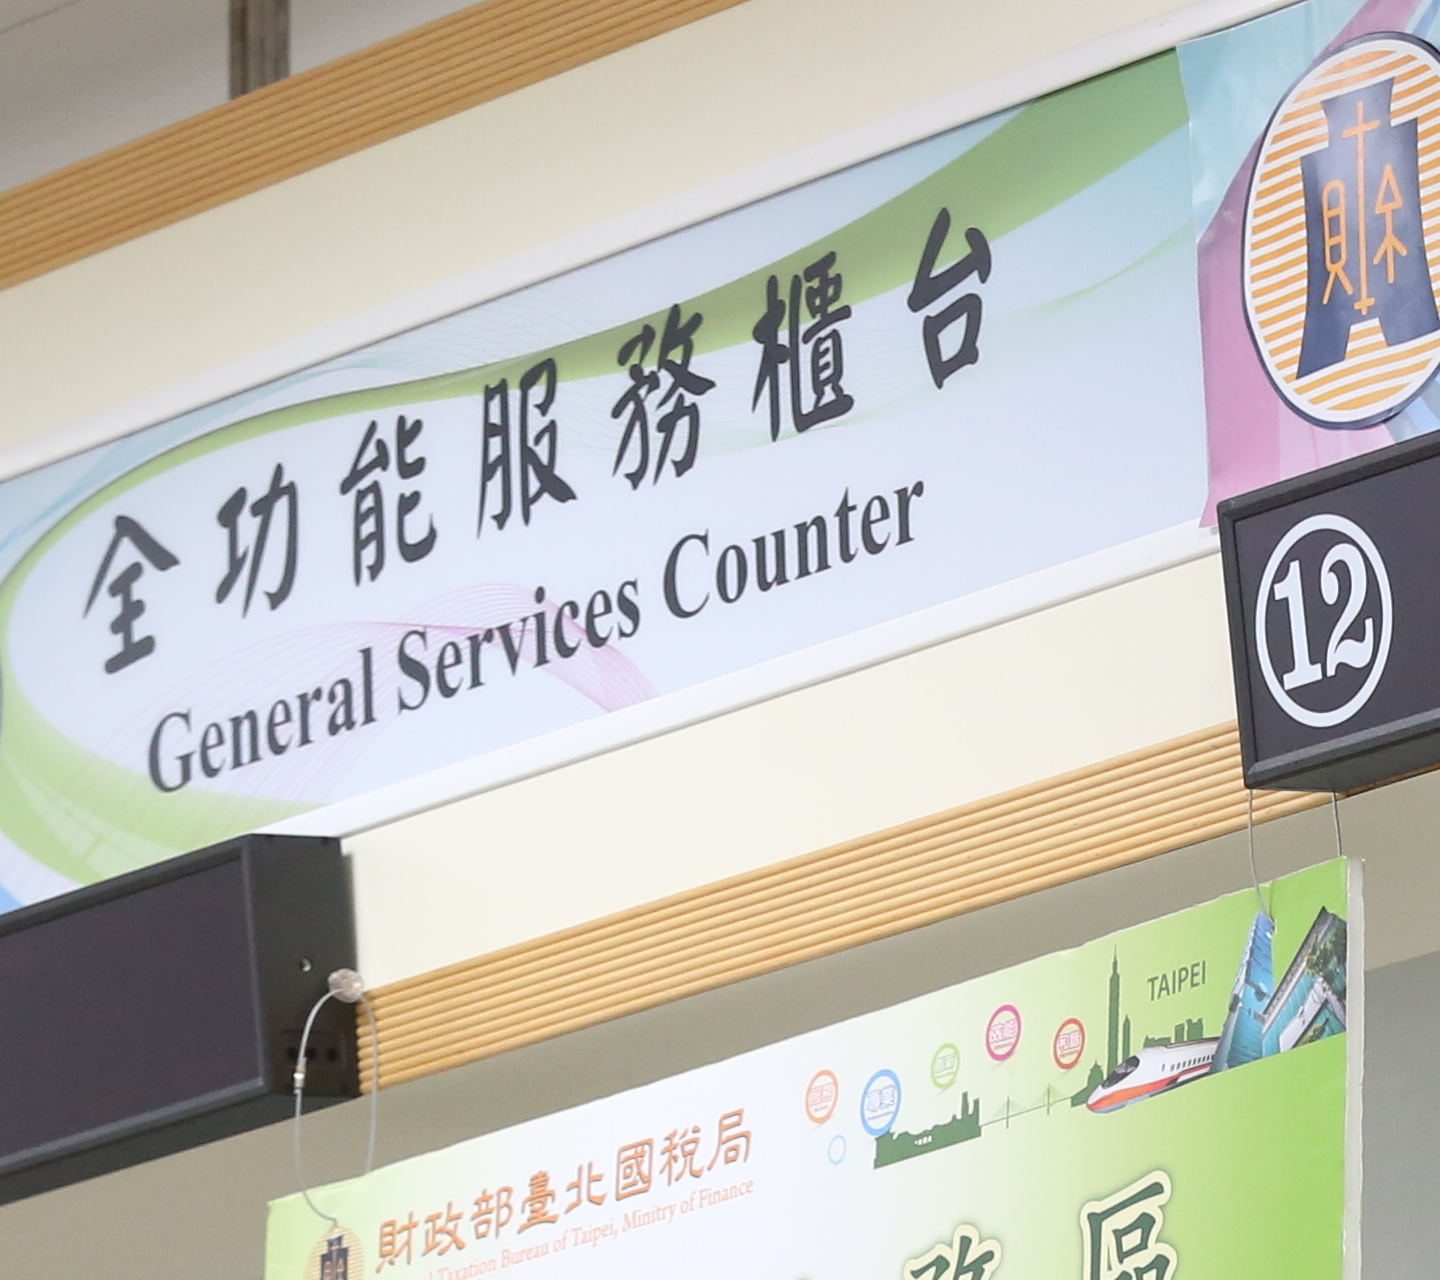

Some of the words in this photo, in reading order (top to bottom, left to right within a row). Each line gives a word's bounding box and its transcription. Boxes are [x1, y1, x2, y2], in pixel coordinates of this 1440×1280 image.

[82, 206, 992, 676] 全功能服務櫃台
[148, 648, 374, 794] General
[397, 577, 641, 713] Services
[663, 480, 925, 619] Counter
[1273, 541, 1374, 692] 12
[1146, 960, 1208, 1003] TAIPEI
[376, 1109, 753, 1273] 財政部臺北國稅局
[501, 1243, 549, 1270] Bureau
[554, 1233, 568, 1254] of
[572, 1217, 619, 1249] Taipei,
[681, 1192, 698, 1216] of
[699, 1179, 755, 1209] Finance
